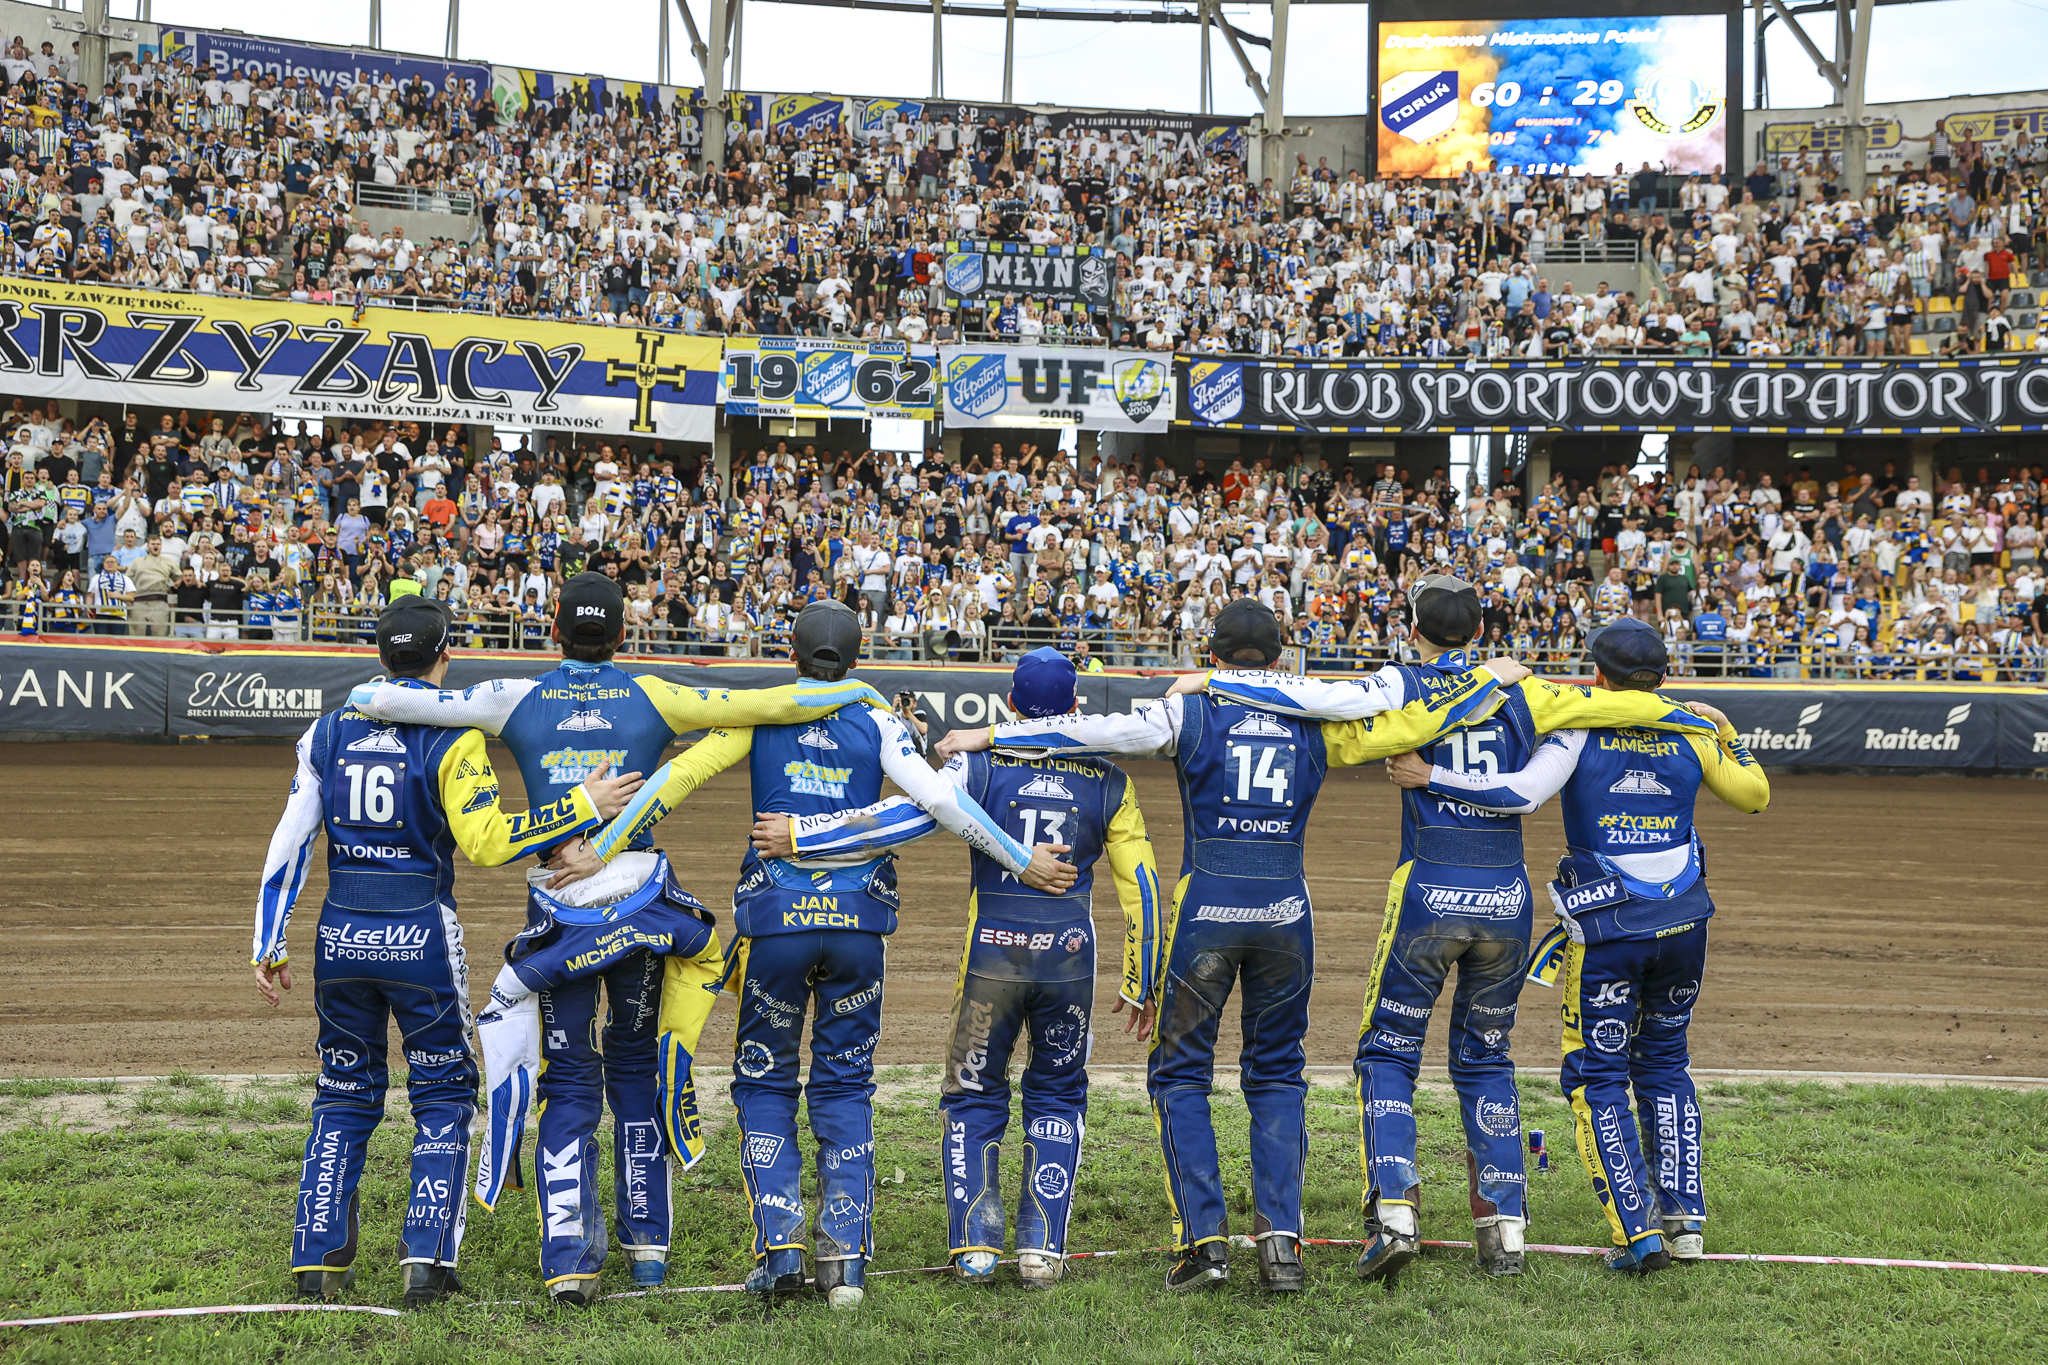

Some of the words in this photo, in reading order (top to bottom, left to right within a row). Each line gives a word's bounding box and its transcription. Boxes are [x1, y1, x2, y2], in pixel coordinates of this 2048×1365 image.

[268, 45, 282, 54] na
[1489, 30, 1600, 48] Mistrzostwa
[1389, 81, 1451, 124] TORUŃ
[1469, 81, 1522, 107] 60
[1539, 85, 1554, 106] :
[1571, 79, 1625, 106] 29
[776, 98, 798, 119] KS
[1120, 118, 1128, 126] W
[1515, 117, 1575, 127] dwumecz
[1480, 131, 1517, 145] 105
[986, 255, 1075, 287] MŁYN
[806, 356, 821, 372] KS
[950, 361, 968, 378] KS
[727, 353, 800, 401] 19
[854, 357, 934, 405] 62
[806, 359, 850, 395] Apator
[954, 359, 1002, 405] Apator
[1018, 358, 1104, 404] UF
[1191, 368, 1207, 384] KS
[1193, 369, 1240, 410] Apator
[1260, 370, 1401, 424] KLUB
[1409, 368, 1716, 430] SPORTOWY
[1728, 369, 1977, 426] APATOR
[298, 400, 332, 412] ALE
[336, 401, 473, 420] NAJWAŻNIEJSZA
[476, 409, 516, 424] JEST
[522, 413, 604, 429] WIERNOŚĆ
[576, 606, 606, 618] BOLL
[390, 633, 413, 645] #512
[568, 682, 602, 691] MIKKEL
[1262, 678, 1306, 688] BANK
[1456, 685, 1470, 697] 1993
[541, 688, 631, 702] MICHELSEN
[187, 709, 211, 718] SIECI
[213, 709, 218, 718] I
[219, 709, 271, 718] INSTALACJE
[273, 709, 322, 719] SANITARNE
[571, 709, 601, 719] ZDB
[1046, 716, 1090, 728] BANK
[1244, 711, 1278, 723] ZDB
[1600, 736, 1680, 758] LAMBERT
[1865, 726, 1961, 751] Raitech
[540, 747, 628, 769] #ŻYJEMY
[1444, 731, 1499, 775] 15
[784, 759, 853, 784] #ŻYJEMY
[1034, 773, 1065, 784] ZDB
[1232, 745, 1289, 803] 14
[1624, 769, 1657, 780] ZDB
[345, 764, 395, 824] 16
[790, 777, 845, 799] ŻUŻLEM
[507, 792, 574, 836] TMC
[1598, 812, 1679, 830] #ŻYJEMY
[520, 827, 543, 840] since
[546, 819, 566, 832] 1993
[1019, 808, 1067, 859] 13
[1240, 818, 1293, 834] ONDE
[1607, 827, 1672, 844] ŻUŻLEM
[352, 845, 411, 859] ONDE
[792, 895, 838, 911] JAN
[1566, 881, 1617, 910] APRO
[782, 911, 859, 928] KVECH
[1432, 902, 1494, 914] SPEEDWAY
[1494, 905, 1519, 917] 429
[595, 924, 638, 947] MIKKEL
[1057, 926, 1090, 946] PROSIACZEK
[338, 948, 424, 962] PODGÓRSKI
[565, 932, 673, 972] MICHELSEN
[746, 978, 800, 1014] Kwiaciarnia
[1589, 980, 1630, 1003] JG
[754, 1003, 763, 1014] u
[762, 1008, 793, 1029] Krysi
[1381, 997, 1432, 1019] BECKHOFF
[826, 1031, 880, 1061] MERCURE
[1052, 1004, 1087, 1067] PROSIACZEK
[1483, 1102, 1517, 1115] Plech
[1032, 1120, 1068, 1136] GM
[1486, 1117, 1515, 1125] SPORT
[749, 1136, 777, 1147] SPEED
[1047, 1135, 1072, 1143] ENGINES
[1682, 1103, 1700, 1194] daytona
[950, 1121, 966, 1180] ANLAS
[1598, 1105, 1642, 1211] GARCAREK
[312, 1130, 341, 1233] PANORAMA
[334, 1157, 348, 1204] RESTAURACJA
[415, 1175, 450, 1203] AS
[407, 1206, 452, 1220] AUTO
[760, 1193, 805, 1217] ANLAS
